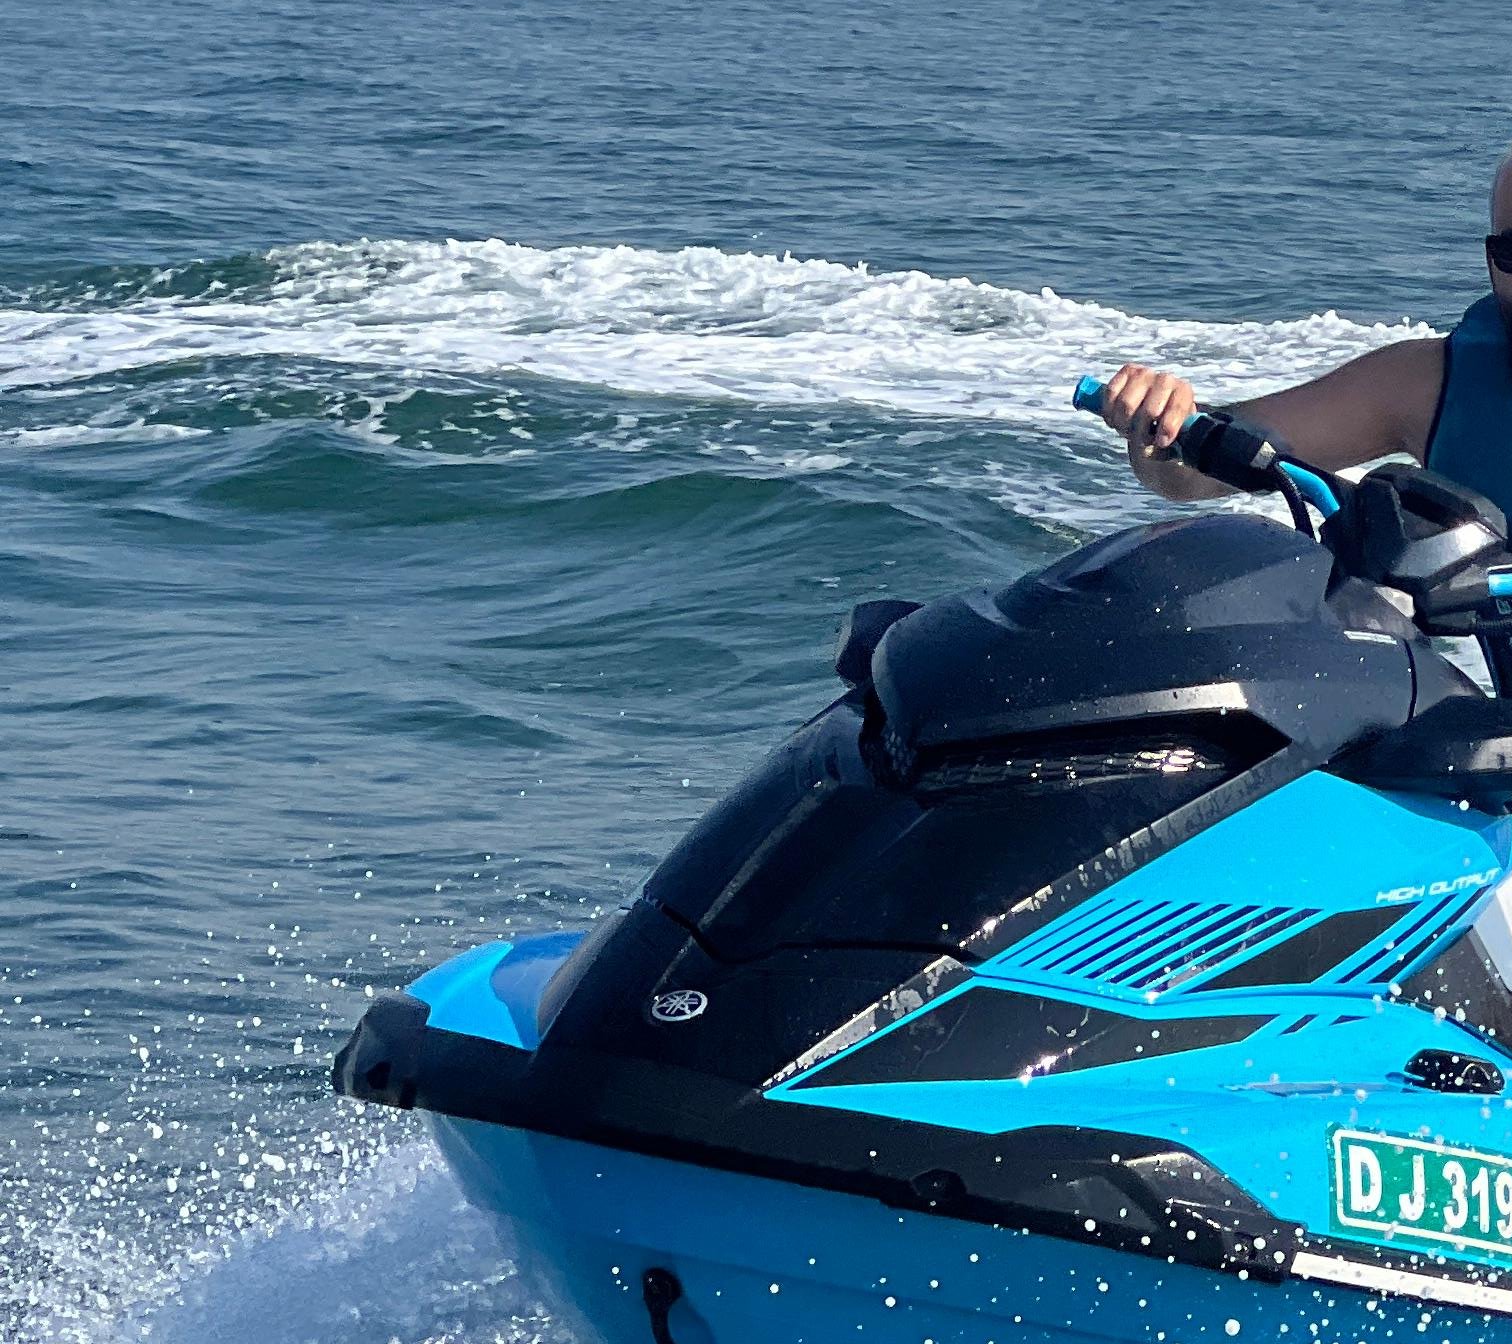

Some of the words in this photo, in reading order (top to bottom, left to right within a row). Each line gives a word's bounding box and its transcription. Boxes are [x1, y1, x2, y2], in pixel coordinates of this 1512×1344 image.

[1376, 885, 1425, 904] HIGH
[1429, 867, 1500, 895] OUTPUT
[1349, 1145, 1382, 1212] D
[1399, 1154, 1425, 1221] J
